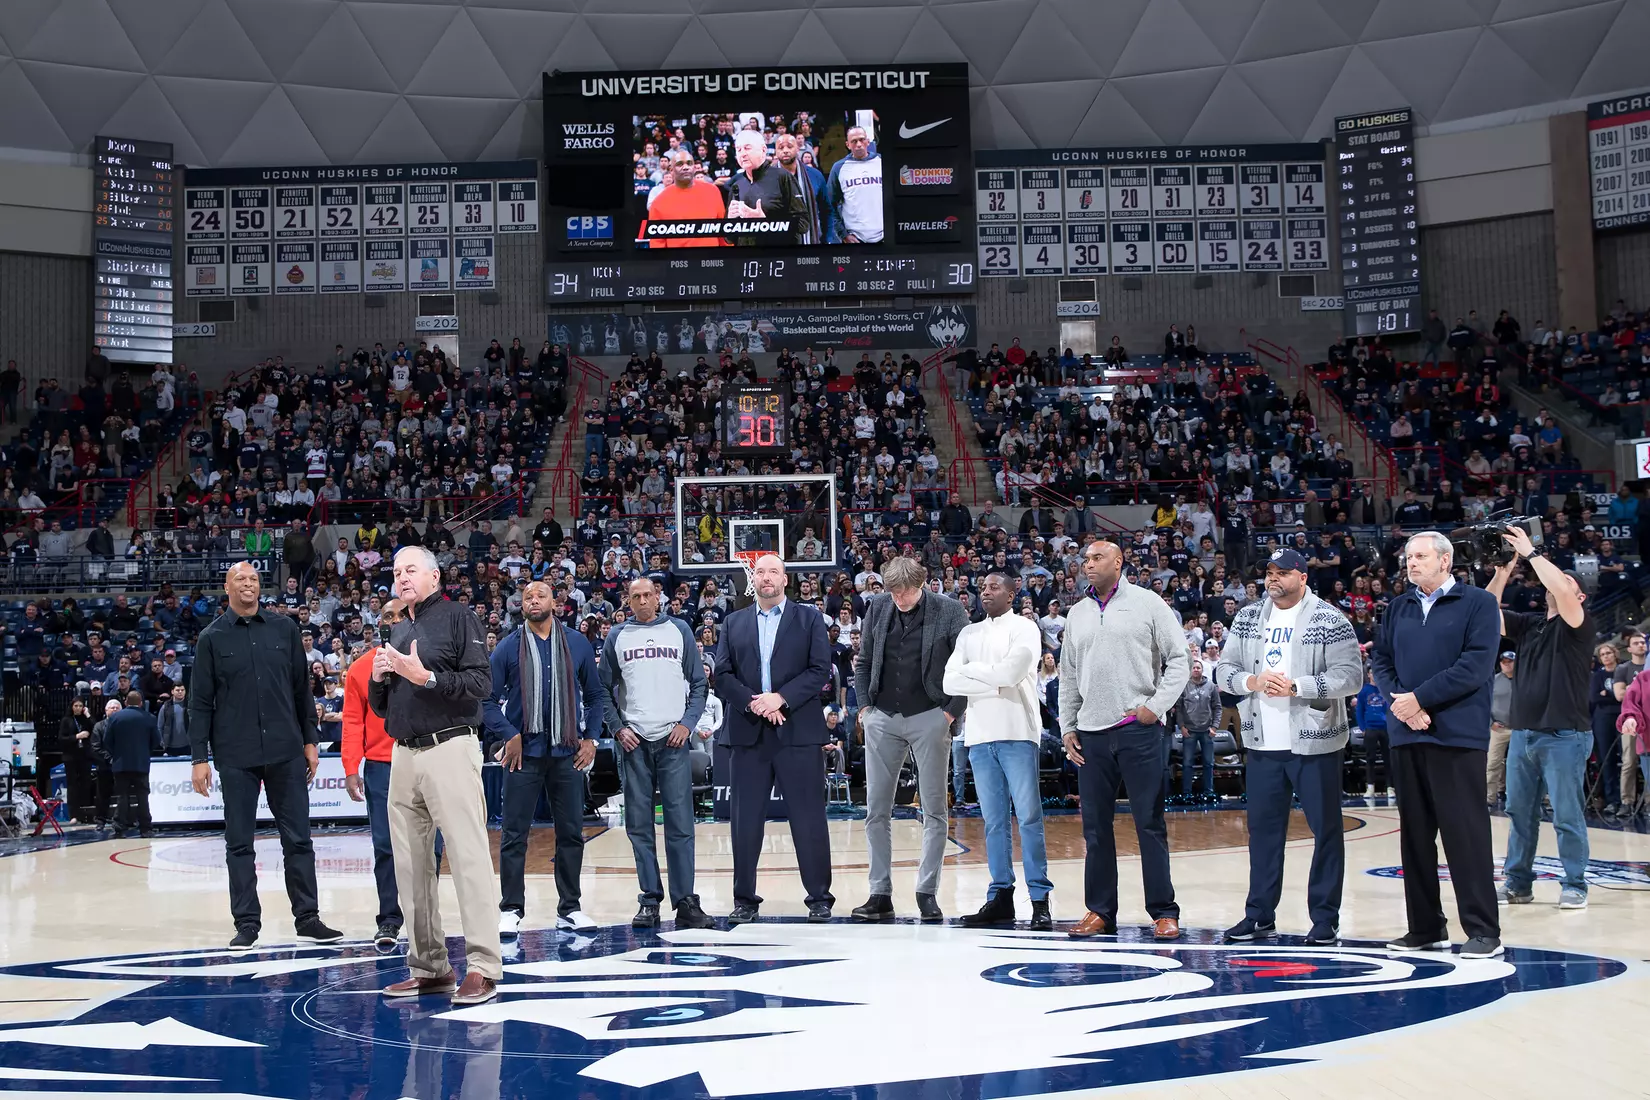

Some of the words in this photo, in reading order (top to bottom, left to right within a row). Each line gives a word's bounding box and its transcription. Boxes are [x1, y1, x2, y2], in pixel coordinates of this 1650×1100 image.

[582, 75, 720, 96] UNIVERSITY
[727, 74, 757, 92] OF
[764, 72, 930, 90] CONNECTICUT
[1339, 120, 1354, 130] GO
[1358, 112, 1408, 127] HUSKIES
[562, 124, 615, 135] WELLS
[1630, 125, 1650, 140] 199
[564, 138, 615, 149] FARGO
[1349, 135, 1368, 146] STAT
[1371, 130, 1400, 143] BOARD
[1596, 130, 1618, 146] 1991
[1052, 152, 1098, 160] UCONN
[1107, 150, 1168, 160] HUSKIES
[1200, 149, 1246, 157] HONOR
[1402, 157, 1412, 166] 39
[1595, 152, 1622, 169] 2000
[262, 171, 309, 179] UCONN
[317, 168, 378, 178] HUSKIES
[412, 167, 458, 176] HONOR
[1342, 166, 1352, 174] 37
[1368, 162, 1383, 170] FG%
[1369, 178, 1383, 186] FT%
[1596, 175, 1622, 192] 2007
[989, 192, 1005, 211] 32
[1037, 191, 1045, 210] 3
[1121, 189, 1138, 209] 20
[1165, 188, 1180, 207] 31
[1208, 187, 1225, 206] 23
[1250, 186, 1269, 206] 31
[1295, 185, 1314, 205] 14
[510, 203, 524, 222] 10
[1404, 205, 1414, 214] 22
[1598, 197, 1623, 214] 2014
[191, 211, 220, 230] 24
[236, 210, 264, 230] 50
[284, 209, 307, 228] 21
[326, 207, 353, 228] 52
[370, 206, 398, 226] 42
[418, 206, 439, 225] 25
[465, 204, 482, 224] 33
[1360, 208, 1396, 219] REBOUNDS
[1596, 213, 1650, 228] CONNEC
[567, 216, 608, 230] CBS
[648, 222, 696, 234] COACH
[697, 223, 719, 234] JIM
[723, 221, 790, 233] CALHOUN
[898, 221, 948, 230] TRAVELERS
[1364, 224, 1393, 234] ASSISTS
[418, 240, 440, 249] NATIONAL
[462, 239, 485, 247] NATIONAL
[1360, 239, 1400, 250] TURNOVERS
[416, 249, 441, 258] CHAMPION
[461, 248, 486, 256] CHAMPION
[986, 247, 1011, 267] 23
[1037, 246, 1049, 266] 4
[1075, 245, 1099, 266] 30
[1125, 244, 1137, 264] 3
[1162, 243, 1187, 264] CD
[1209, 242, 1228, 262] 15
[1248, 242, 1278, 261] 24
[1293, 241, 1322, 260] 33
[236, 254, 265, 262] CHAMPION
[1367, 256, 1394, 265] BLOCKS
[743, 260, 784, 278] 10:12
[948, 263, 973, 284] 30
[554, 273, 578, 294] 34
[1369, 272, 1394, 281] STEALS
[628, 286, 634, 296] 2
[636, 286, 647, 296] 30
[648, 286, 664, 295] SEC
[679, 285, 685, 296] 0
[688, 285, 700, 295] TM
[702, 285, 717, 294] FLS
[806, 282, 818, 291] TM
[820, 281, 835, 291] FLS
[839, 281, 845, 291] 0
[857, 281, 868, 290] 30
[870, 280, 886, 290] SEC
[888, 280, 895, 290] 2
[907, 280, 926, 289] FULL
[595, 288, 614, 297] FULL
[1074, 304, 1098, 314] 204
[1319, 298, 1344, 308] 205
[1356, 302, 1377, 313] TIME
[1380, 301, 1390, 310] OF
[1393, 299, 1410, 309] DAY
[433, 318, 458, 328] 202
[771, 315, 795, 323] Harry
[796, 314, 806, 323] A.
[808, 313, 841, 324] Gampel
[842, 313, 875, 322] Pavilion
[884, 312, 911, 321] Storrs,
[913, 311, 924, 320] CT
[193, 324, 215, 334] 201
[783, 325, 827, 334] Basketball
[829, 325, 859, 334] Capital
[872, 324, 886, 332] the
[887, 323, 914, 332] World
[739, 395, 779, 412] 10:12
[739, 416, 774, 446] 30
[1602, 526, 1630, 538] 105
[623, 647, 678, 661] UCONN
